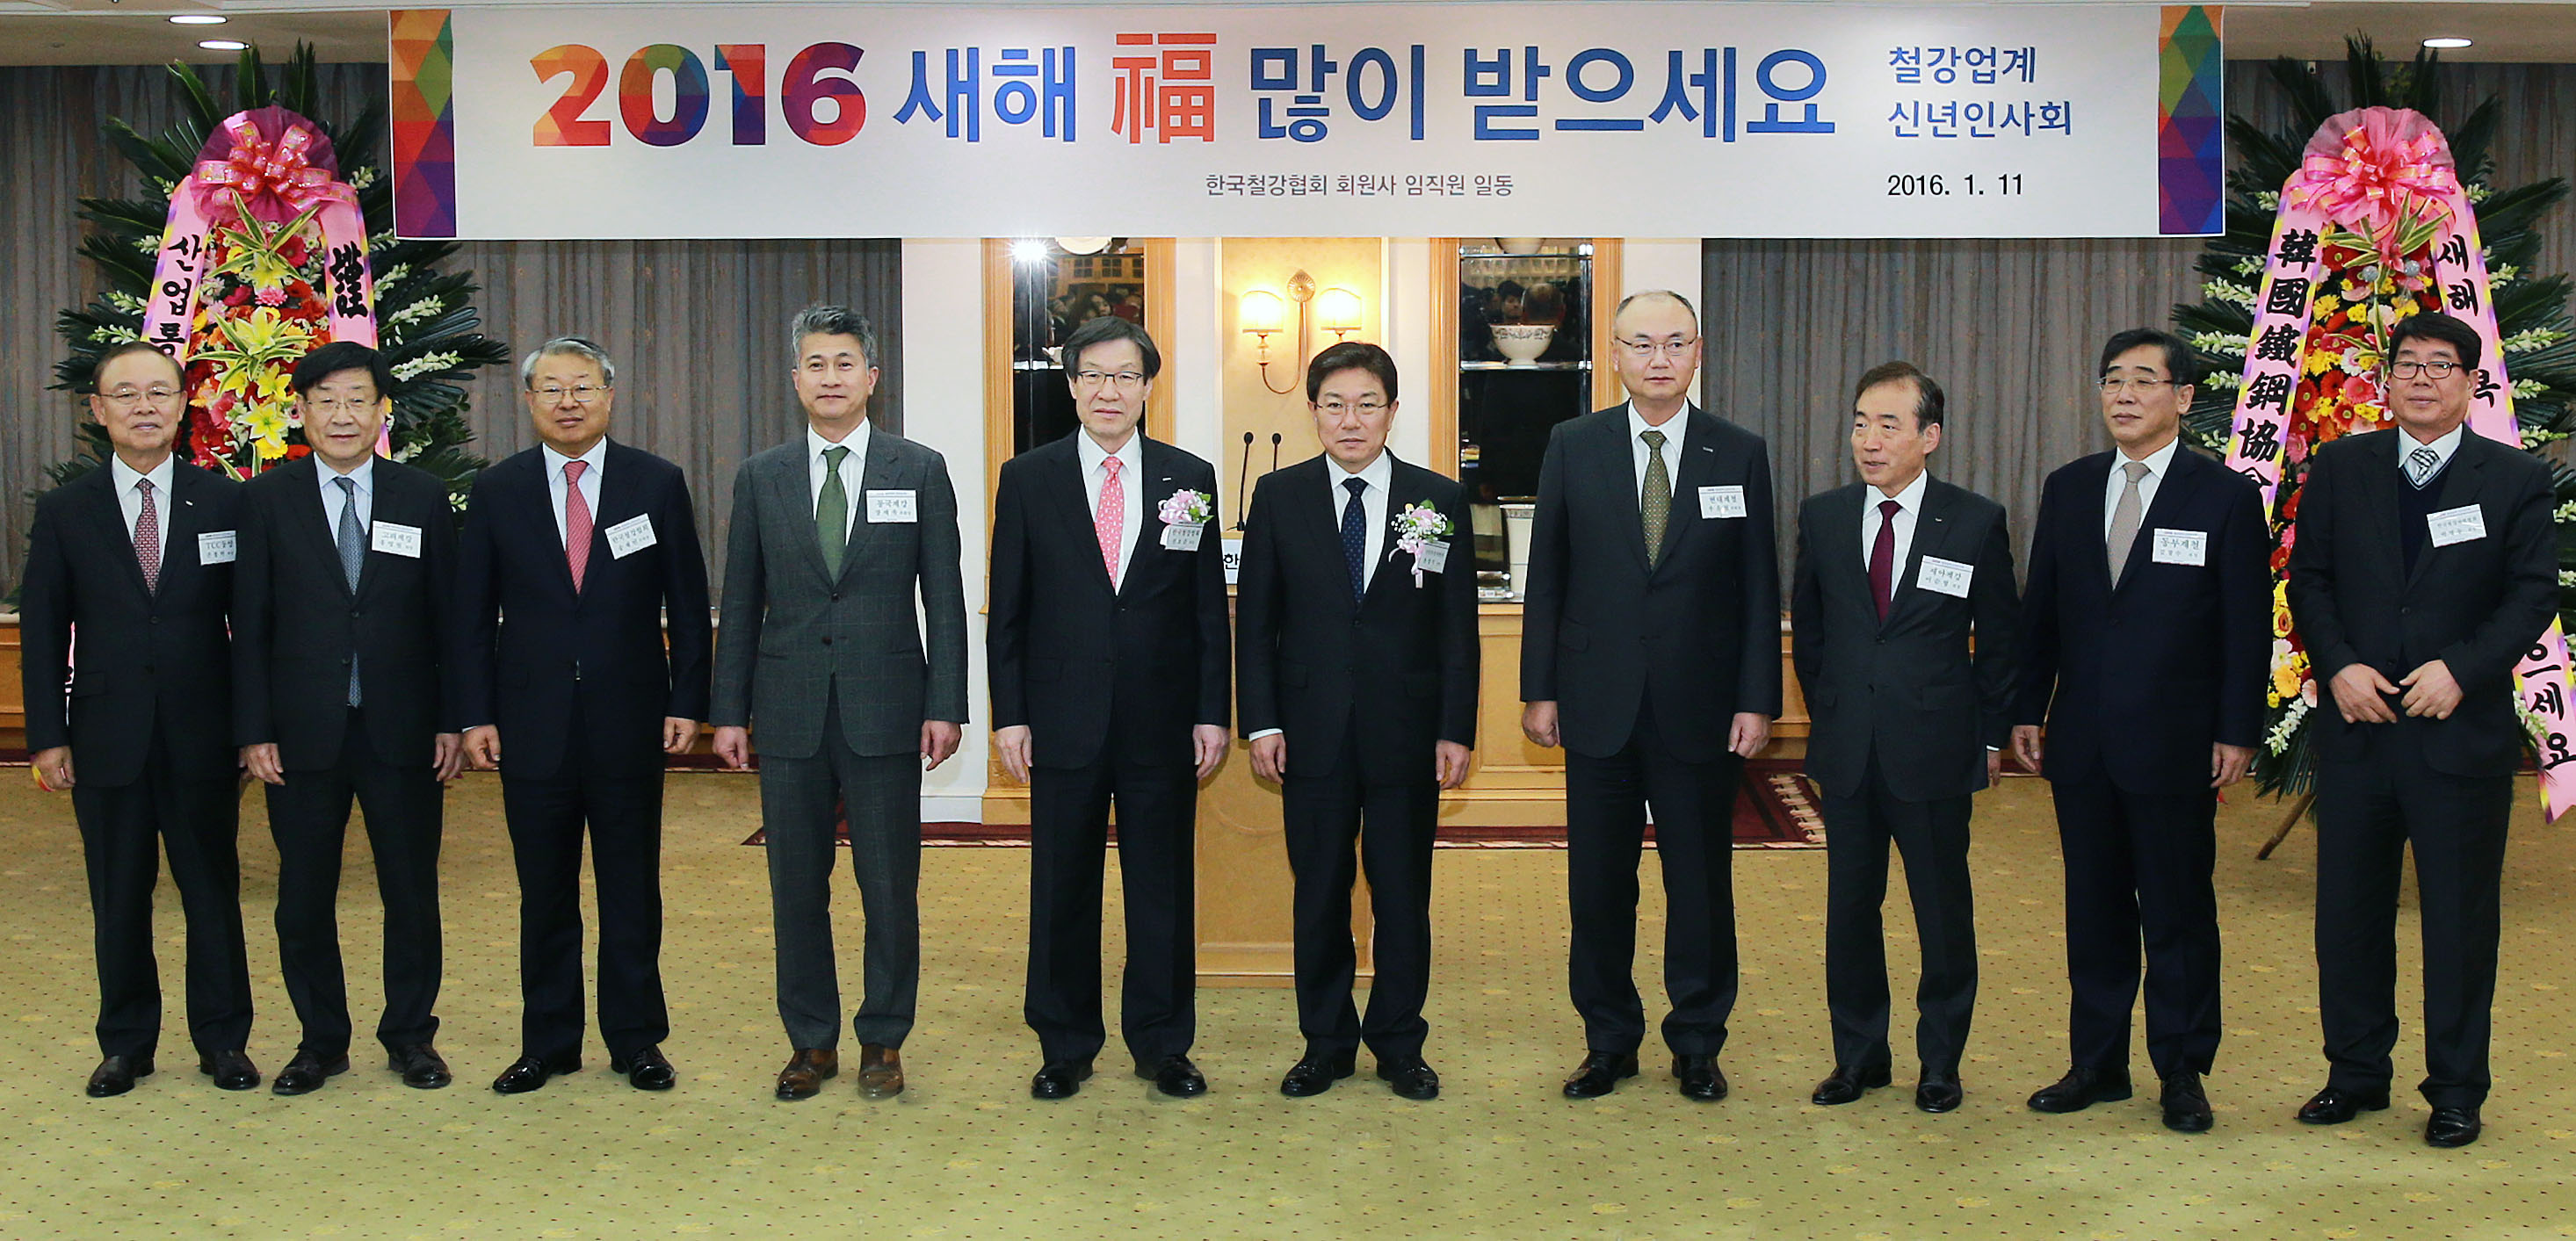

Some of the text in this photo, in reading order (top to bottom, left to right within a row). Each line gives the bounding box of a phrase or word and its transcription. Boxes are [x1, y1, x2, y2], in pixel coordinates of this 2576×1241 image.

[1888, 47, 2037, 85] 철강업계
[530, 32, 1835, 147] 2016 새해 福 많이 받으세요
[1887, 100, 2073, 138] 신년인사회
[1205, 173, 1514, 197] 한국철강협회 회원사 임직원 일동
[1887, 174, 2024, 198] 2016. 1. 11
